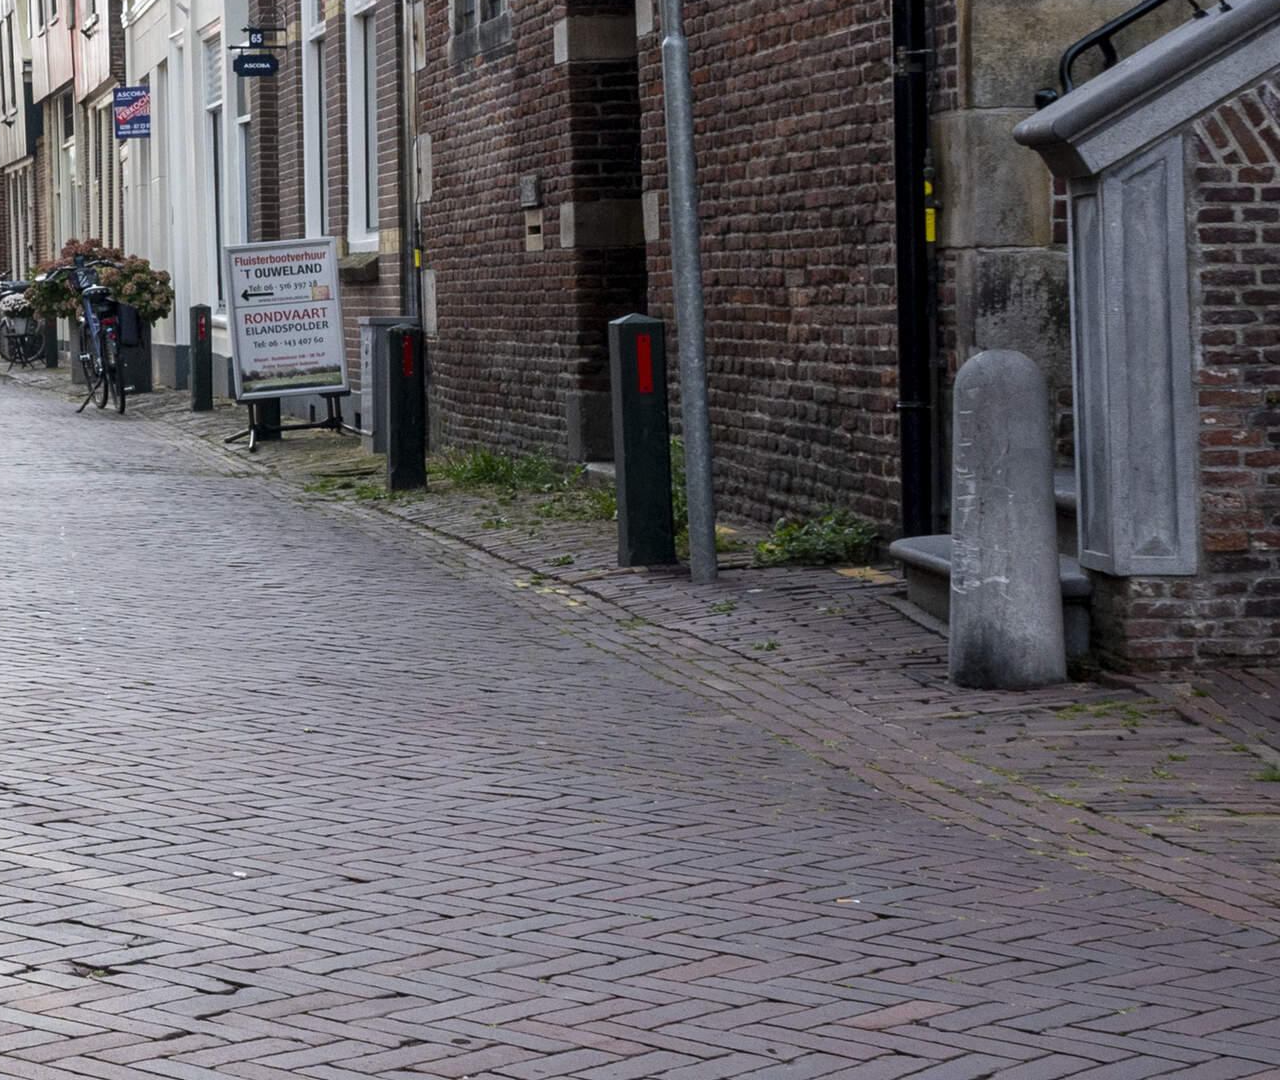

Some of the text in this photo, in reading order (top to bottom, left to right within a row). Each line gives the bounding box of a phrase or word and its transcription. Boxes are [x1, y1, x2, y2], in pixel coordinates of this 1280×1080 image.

[251, 33, 262, 43] 65
[234, 251, 326, 267] Fluisterbootverhuur
[254, 263, 322, 279] OUWELAND
[263, 283, 274, 291] 06
[244, 307, 328, 324] RONDVAART
[245, 321, 329, 336] EILANDSPOLDER
[313, 336, 324, 344] 60
